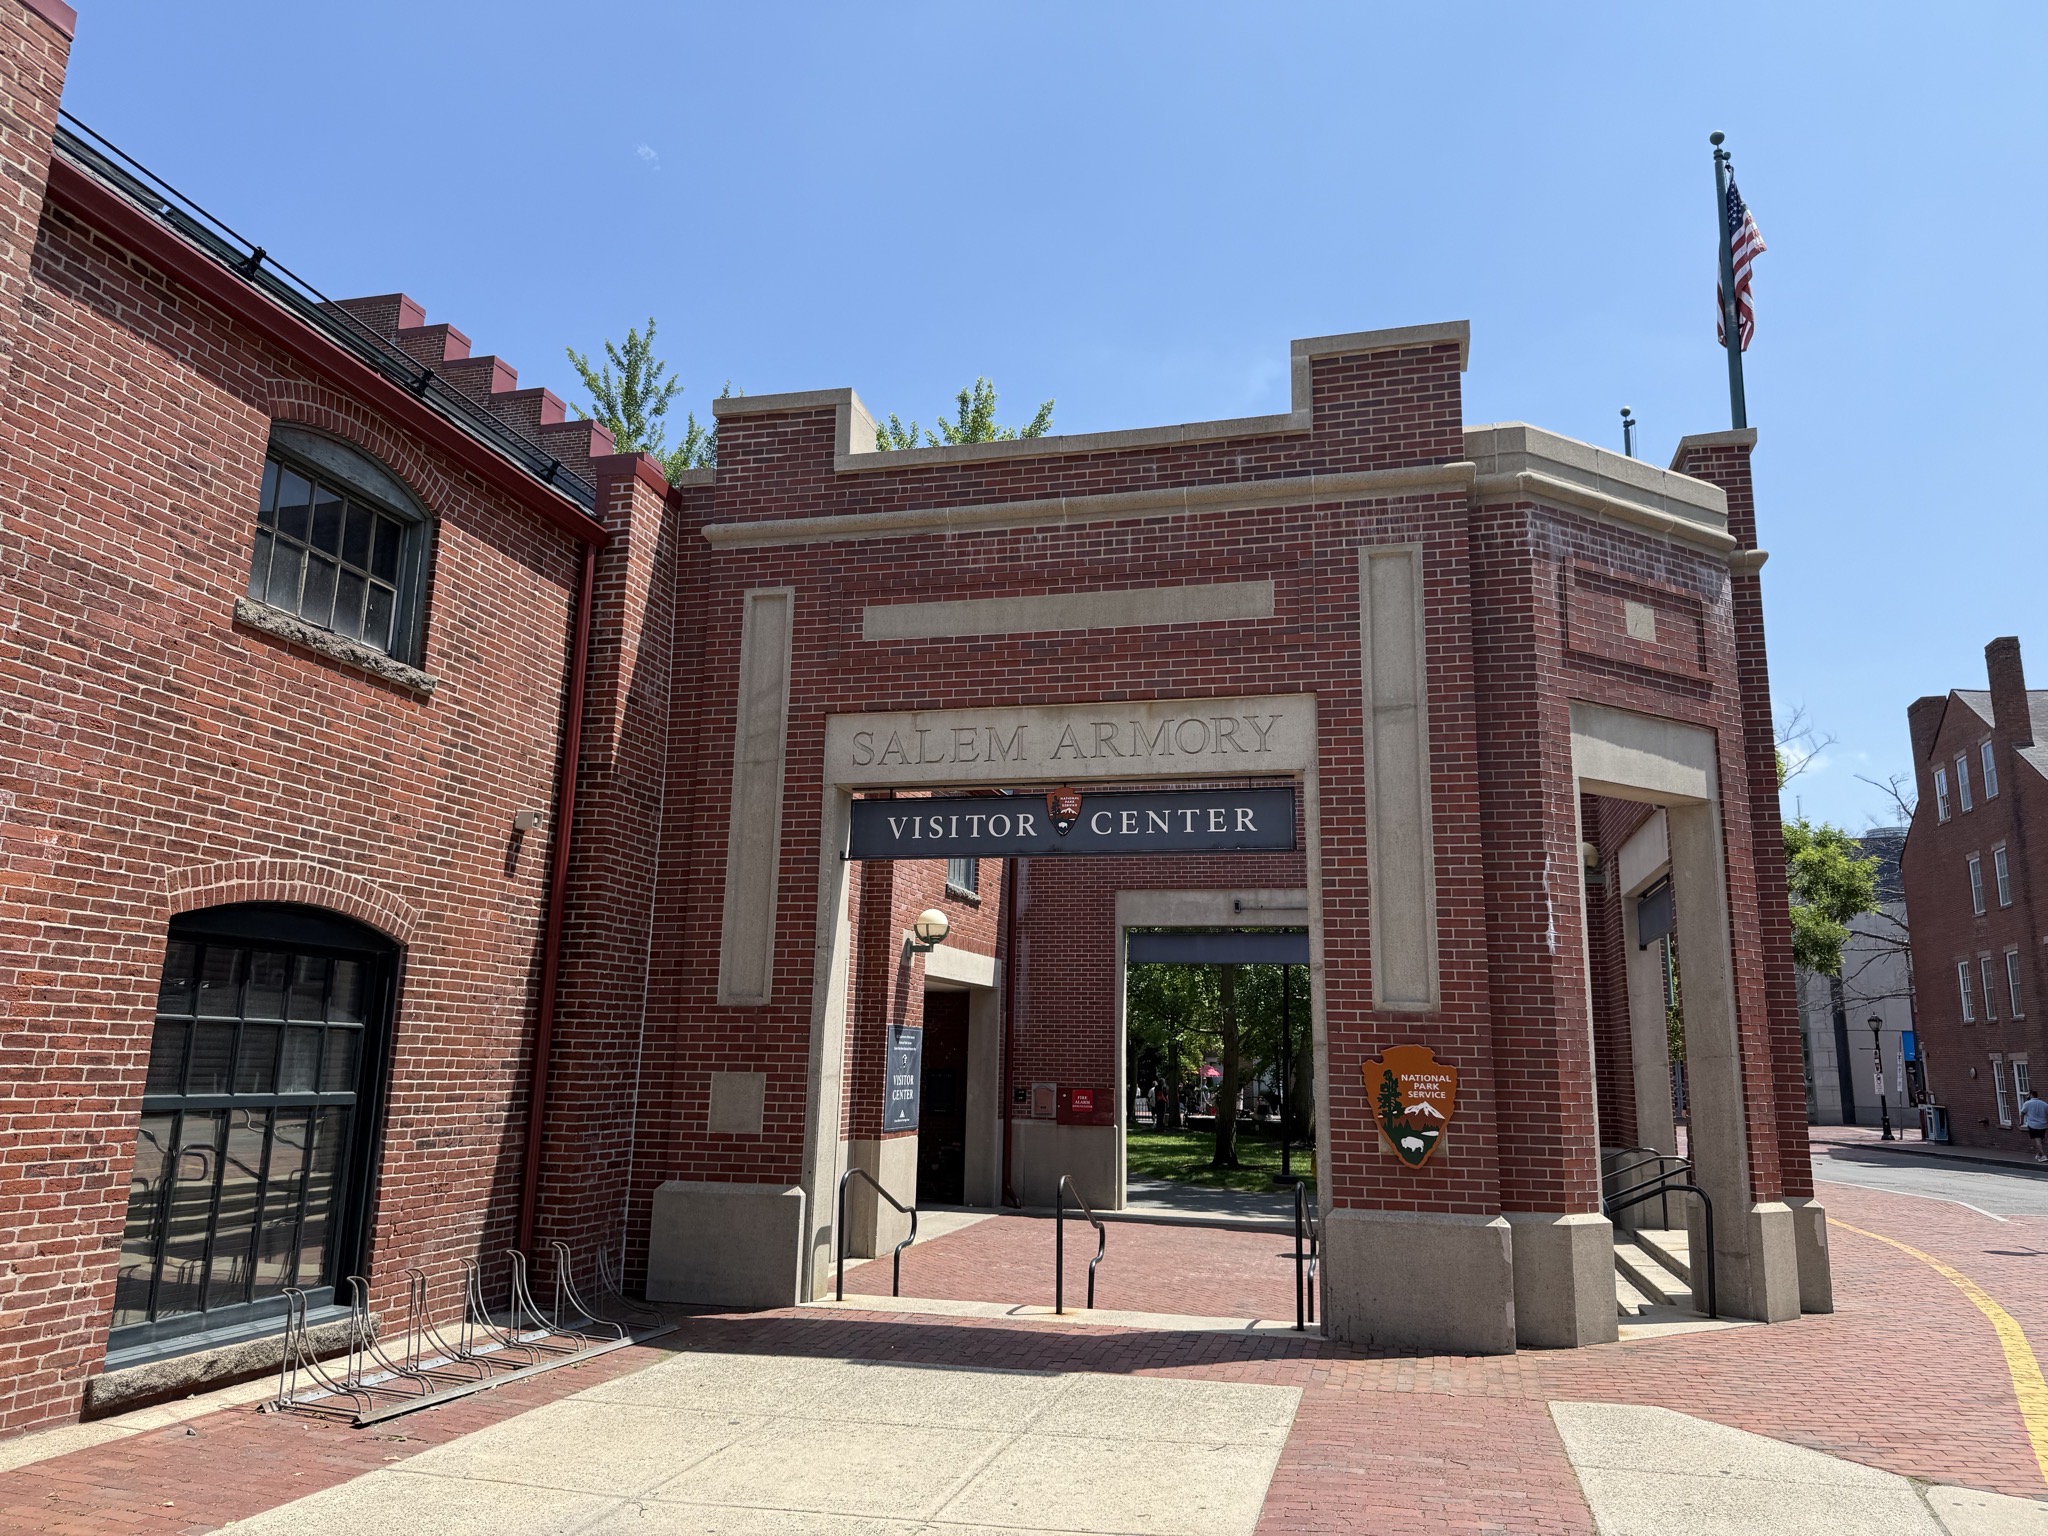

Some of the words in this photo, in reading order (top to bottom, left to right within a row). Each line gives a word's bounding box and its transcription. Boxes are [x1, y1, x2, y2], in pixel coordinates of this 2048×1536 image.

[852, 725, 1029, 766] SALEM
[1049, 714, 1283, 760] ARMORY
[887, 813, 1038, 840] VISITOR
[1090, 808, 1258, 835] CENTER
[893, 1074, 914, 1086] VISITOR
[1401, 1074, 1452, 1083] NATIONAL
[1413, 1082, 1439, 1091] PARK
[892, 1089, 914, 1101] CENTER
[1407, 1091, 1446, 1099] SERVICE
